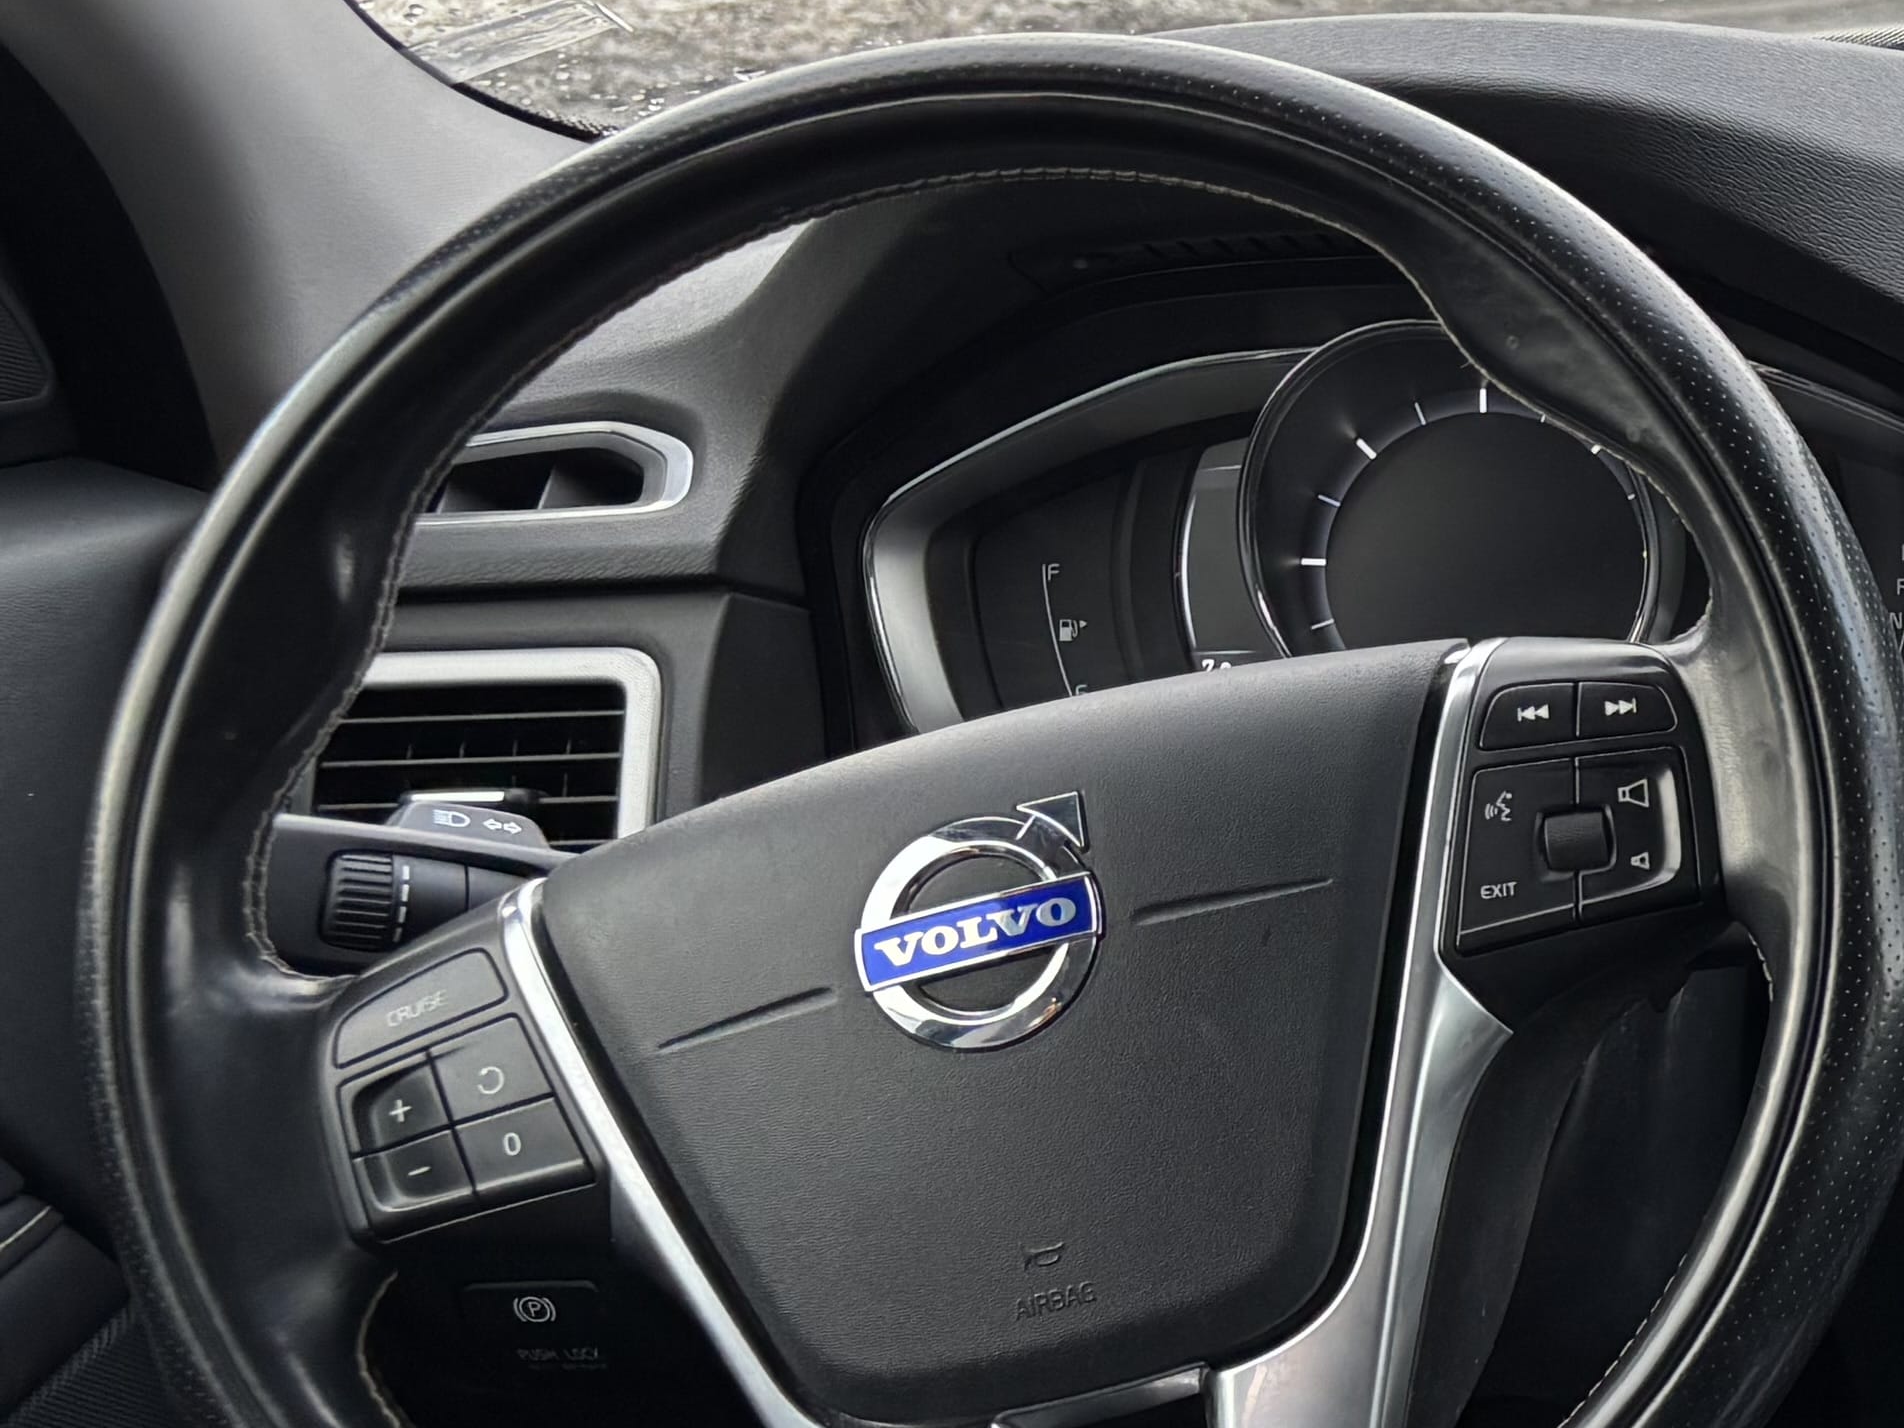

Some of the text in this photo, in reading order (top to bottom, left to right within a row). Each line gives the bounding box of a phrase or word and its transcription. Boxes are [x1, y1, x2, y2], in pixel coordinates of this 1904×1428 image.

[1480, 881, 1518, 900] EXIT
[873, 897, 1077, 967] VOLVO
[386, 989, 448, 1028] CRUISE
[1015, 1280, 1097, 1321] AIRBAG
